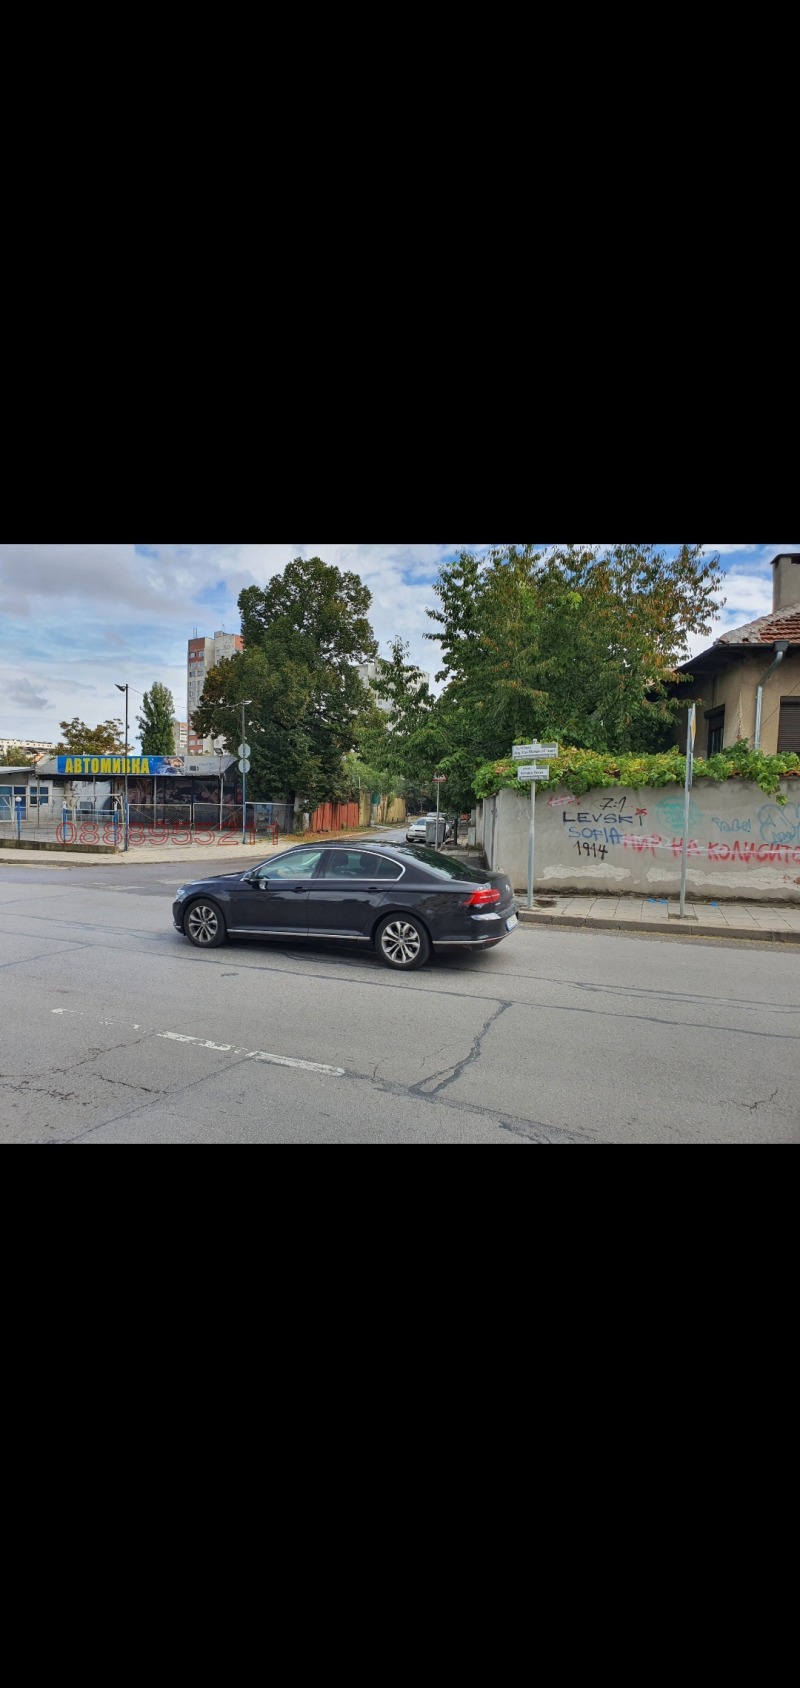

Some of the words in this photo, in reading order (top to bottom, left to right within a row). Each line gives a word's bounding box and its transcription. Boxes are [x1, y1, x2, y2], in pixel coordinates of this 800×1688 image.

[64, 757, 150, 775] АВТОМИВКА
[568, 826, 623, 845] SOFIA
[574, 840, 608, 860] 1914
